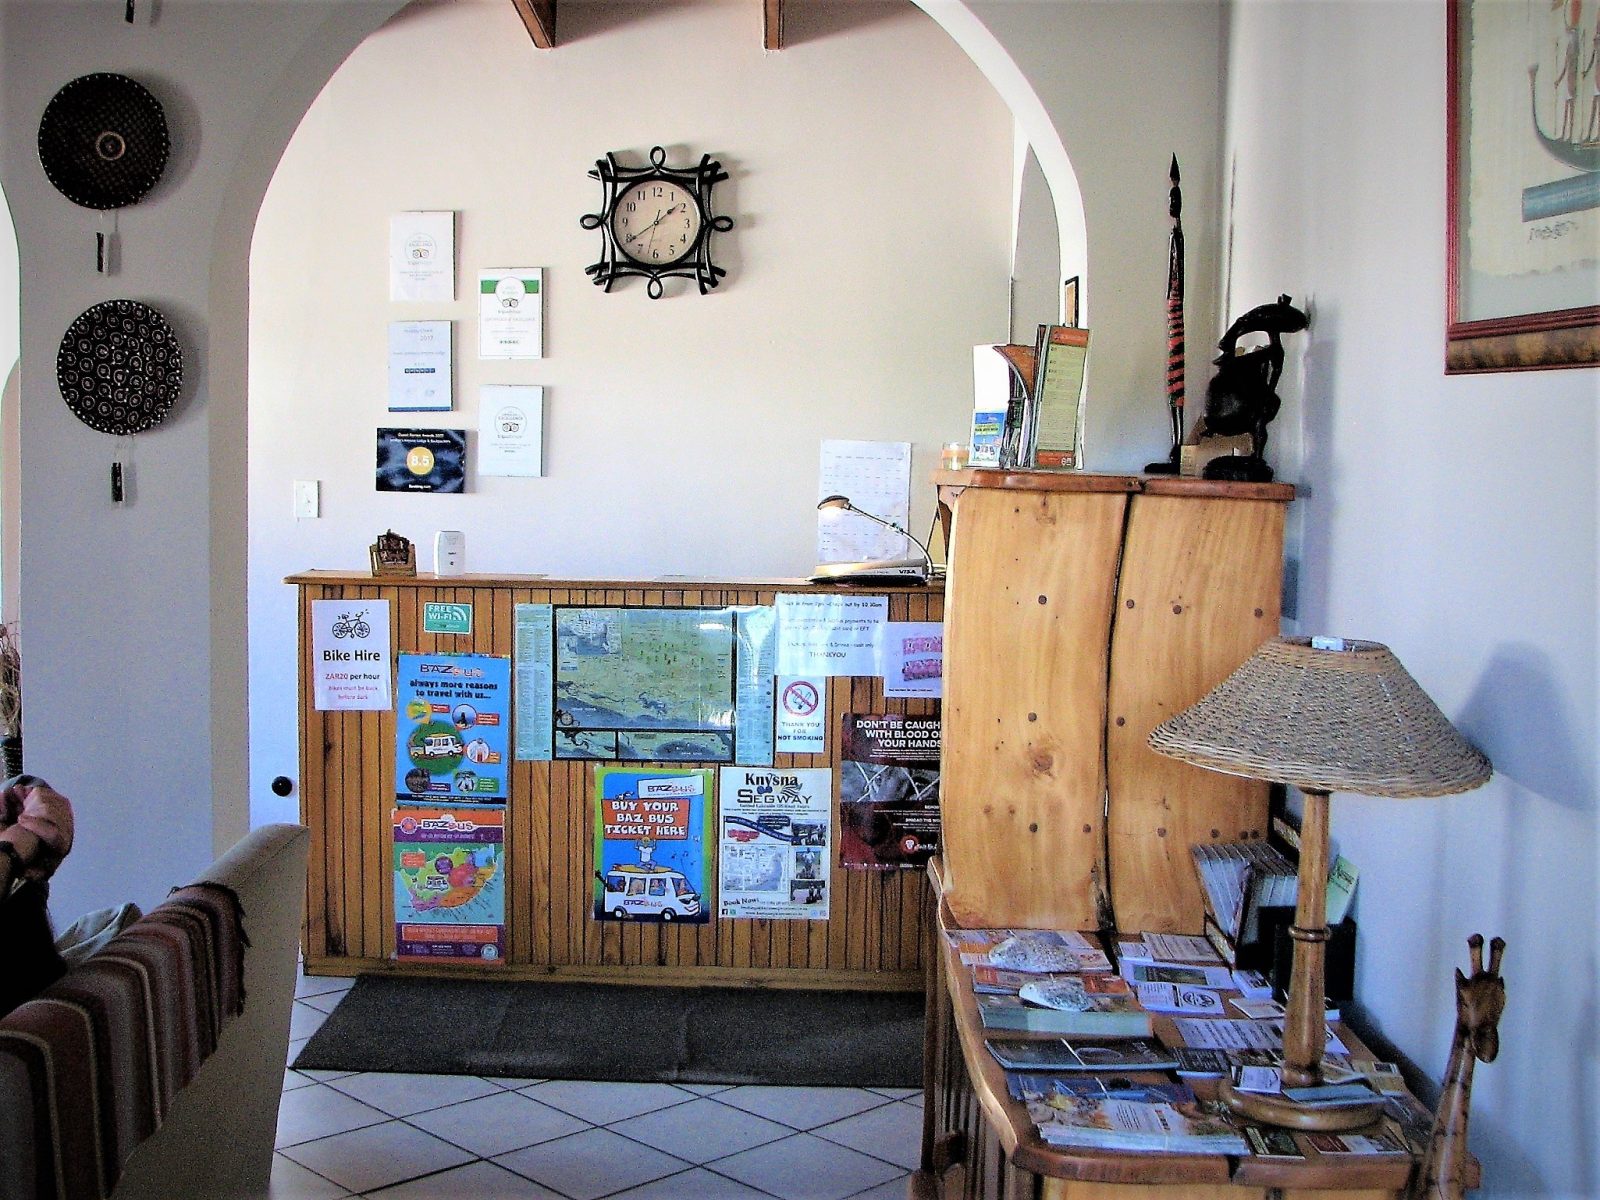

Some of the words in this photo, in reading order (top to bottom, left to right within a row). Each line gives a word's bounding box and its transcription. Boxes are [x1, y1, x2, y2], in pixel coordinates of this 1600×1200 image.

[637, 190, 646, 201] 11
[653, 186, 663, 198] 12
[670, 191, 674, 201] 1
[626, 202, 636, 212] 10
[680, 203, 686, 213] 2
[622, 218, 628, 227] 9
[685, 219, 690, 229] 3
[680, 233, 686, 244] 4
[637, 244, 643, 254] 7
[653, 249, 659, 259] 6
[669, 245, 675, 255] 5
[411, 455, 431, 466] 8.5
[428, 604, 452, 612] FREE
[428, 612, 452, 620] WI-FI
[323, 649, 351, 661] Bike
[354, 649, 381, 661] Hire
[409, 679, 438, 688] always
[465, 682, 498, 690] reasons
[454, 690, 473, 698] with
[856, 720, 888, 729] DON'T
[890, 721, 903, 729] BE
[905, 721, 940, 730] CAUGH
[865, 730, 892, 738] WITH
[894, 730, 929, 739] BLOOD
[877, 739, 906, 747] YOUR
[907, 740, 941, 748] HANDS
[745, 772, 799, 786] Knysna
[737, 789, 813, 804] SEGWAY
[612, 801, 638, 811] BUY
[643, 801, 679, 812] YOUR
[617, 813, 644, 823] BAZ
[648, 814, 674, 824] BUS
[604, 824, 652, 835] TICKET
[656, 825, 686, 836] HERE
